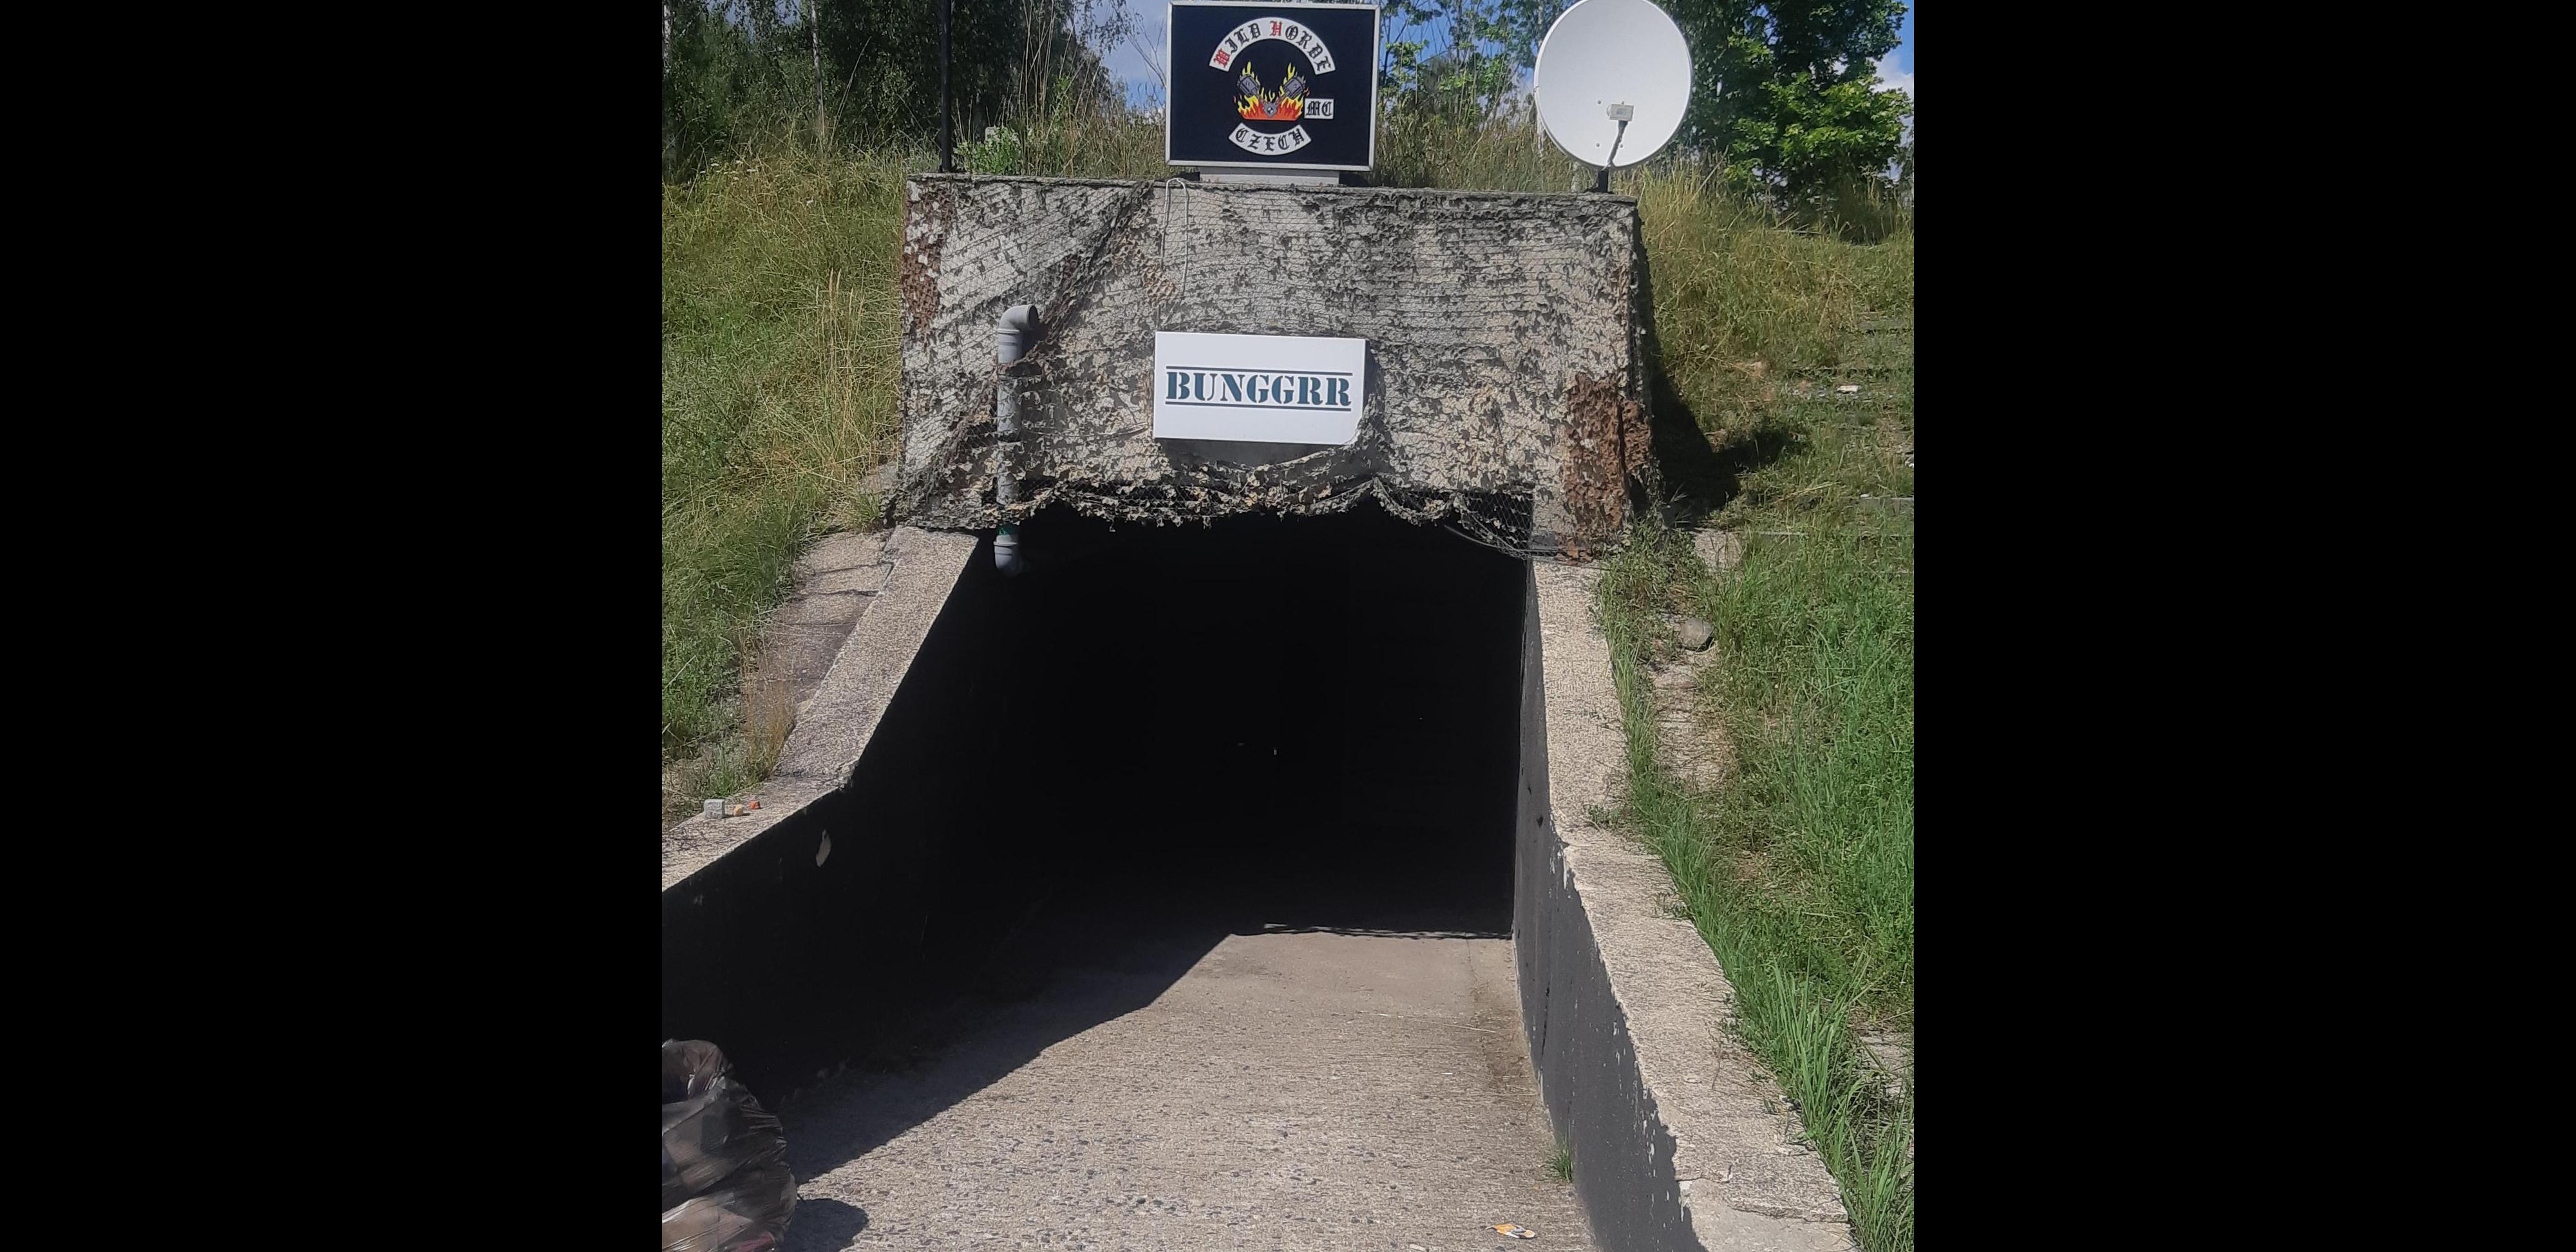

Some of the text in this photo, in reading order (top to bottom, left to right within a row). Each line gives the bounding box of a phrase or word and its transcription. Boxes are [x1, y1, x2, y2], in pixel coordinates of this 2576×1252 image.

[1214, 21, 1331, 71] WILD HORDE
[1305, 100, 1332, 117] MC
[1235, 128, 1305, 151] CZECH
[1166, 372, 1351, 406] BUNGGRR
